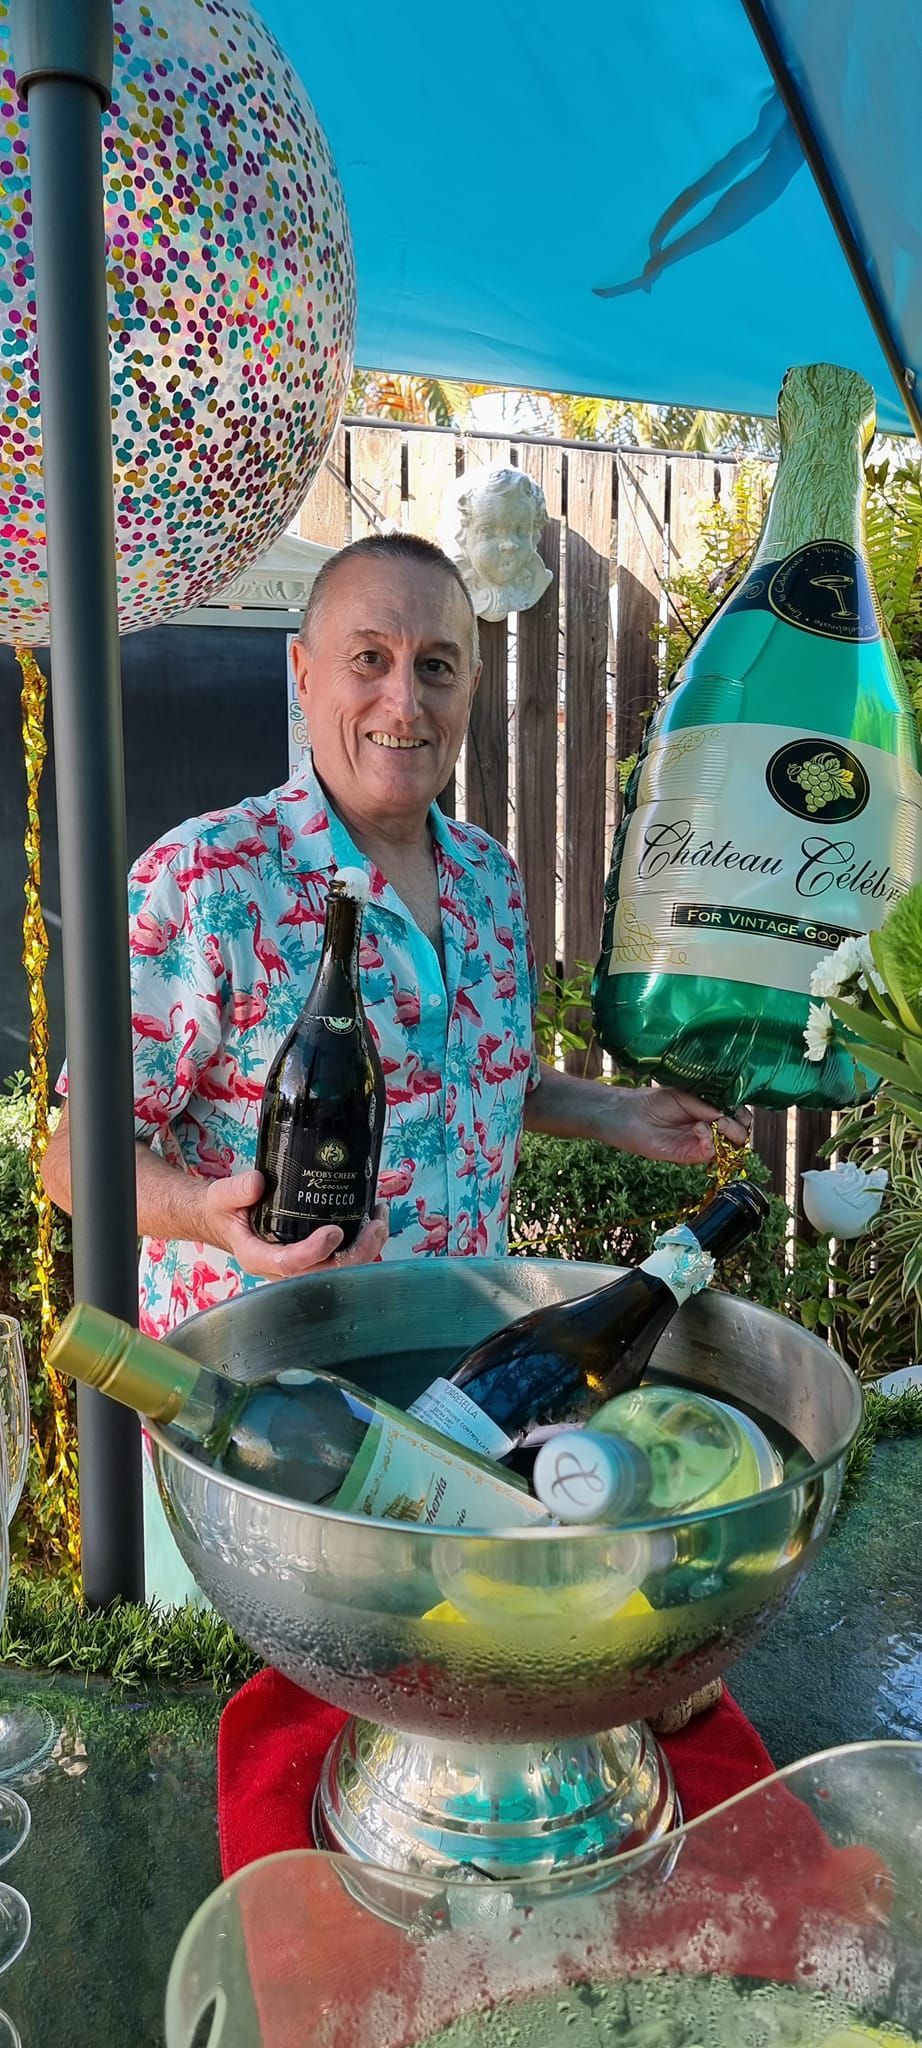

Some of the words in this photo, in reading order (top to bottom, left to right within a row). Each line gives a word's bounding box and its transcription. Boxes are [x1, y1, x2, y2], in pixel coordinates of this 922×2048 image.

[638, 819, 783, 880] Château
[795, 836, 903, 902] Célébr
[687, 909, 722, 925] FOR
[728, 912, 800, 936] VINTAGE
[307, 1178, 350, 1190] Reserve
[297, 1190, 355, 1206] PROSECCO
